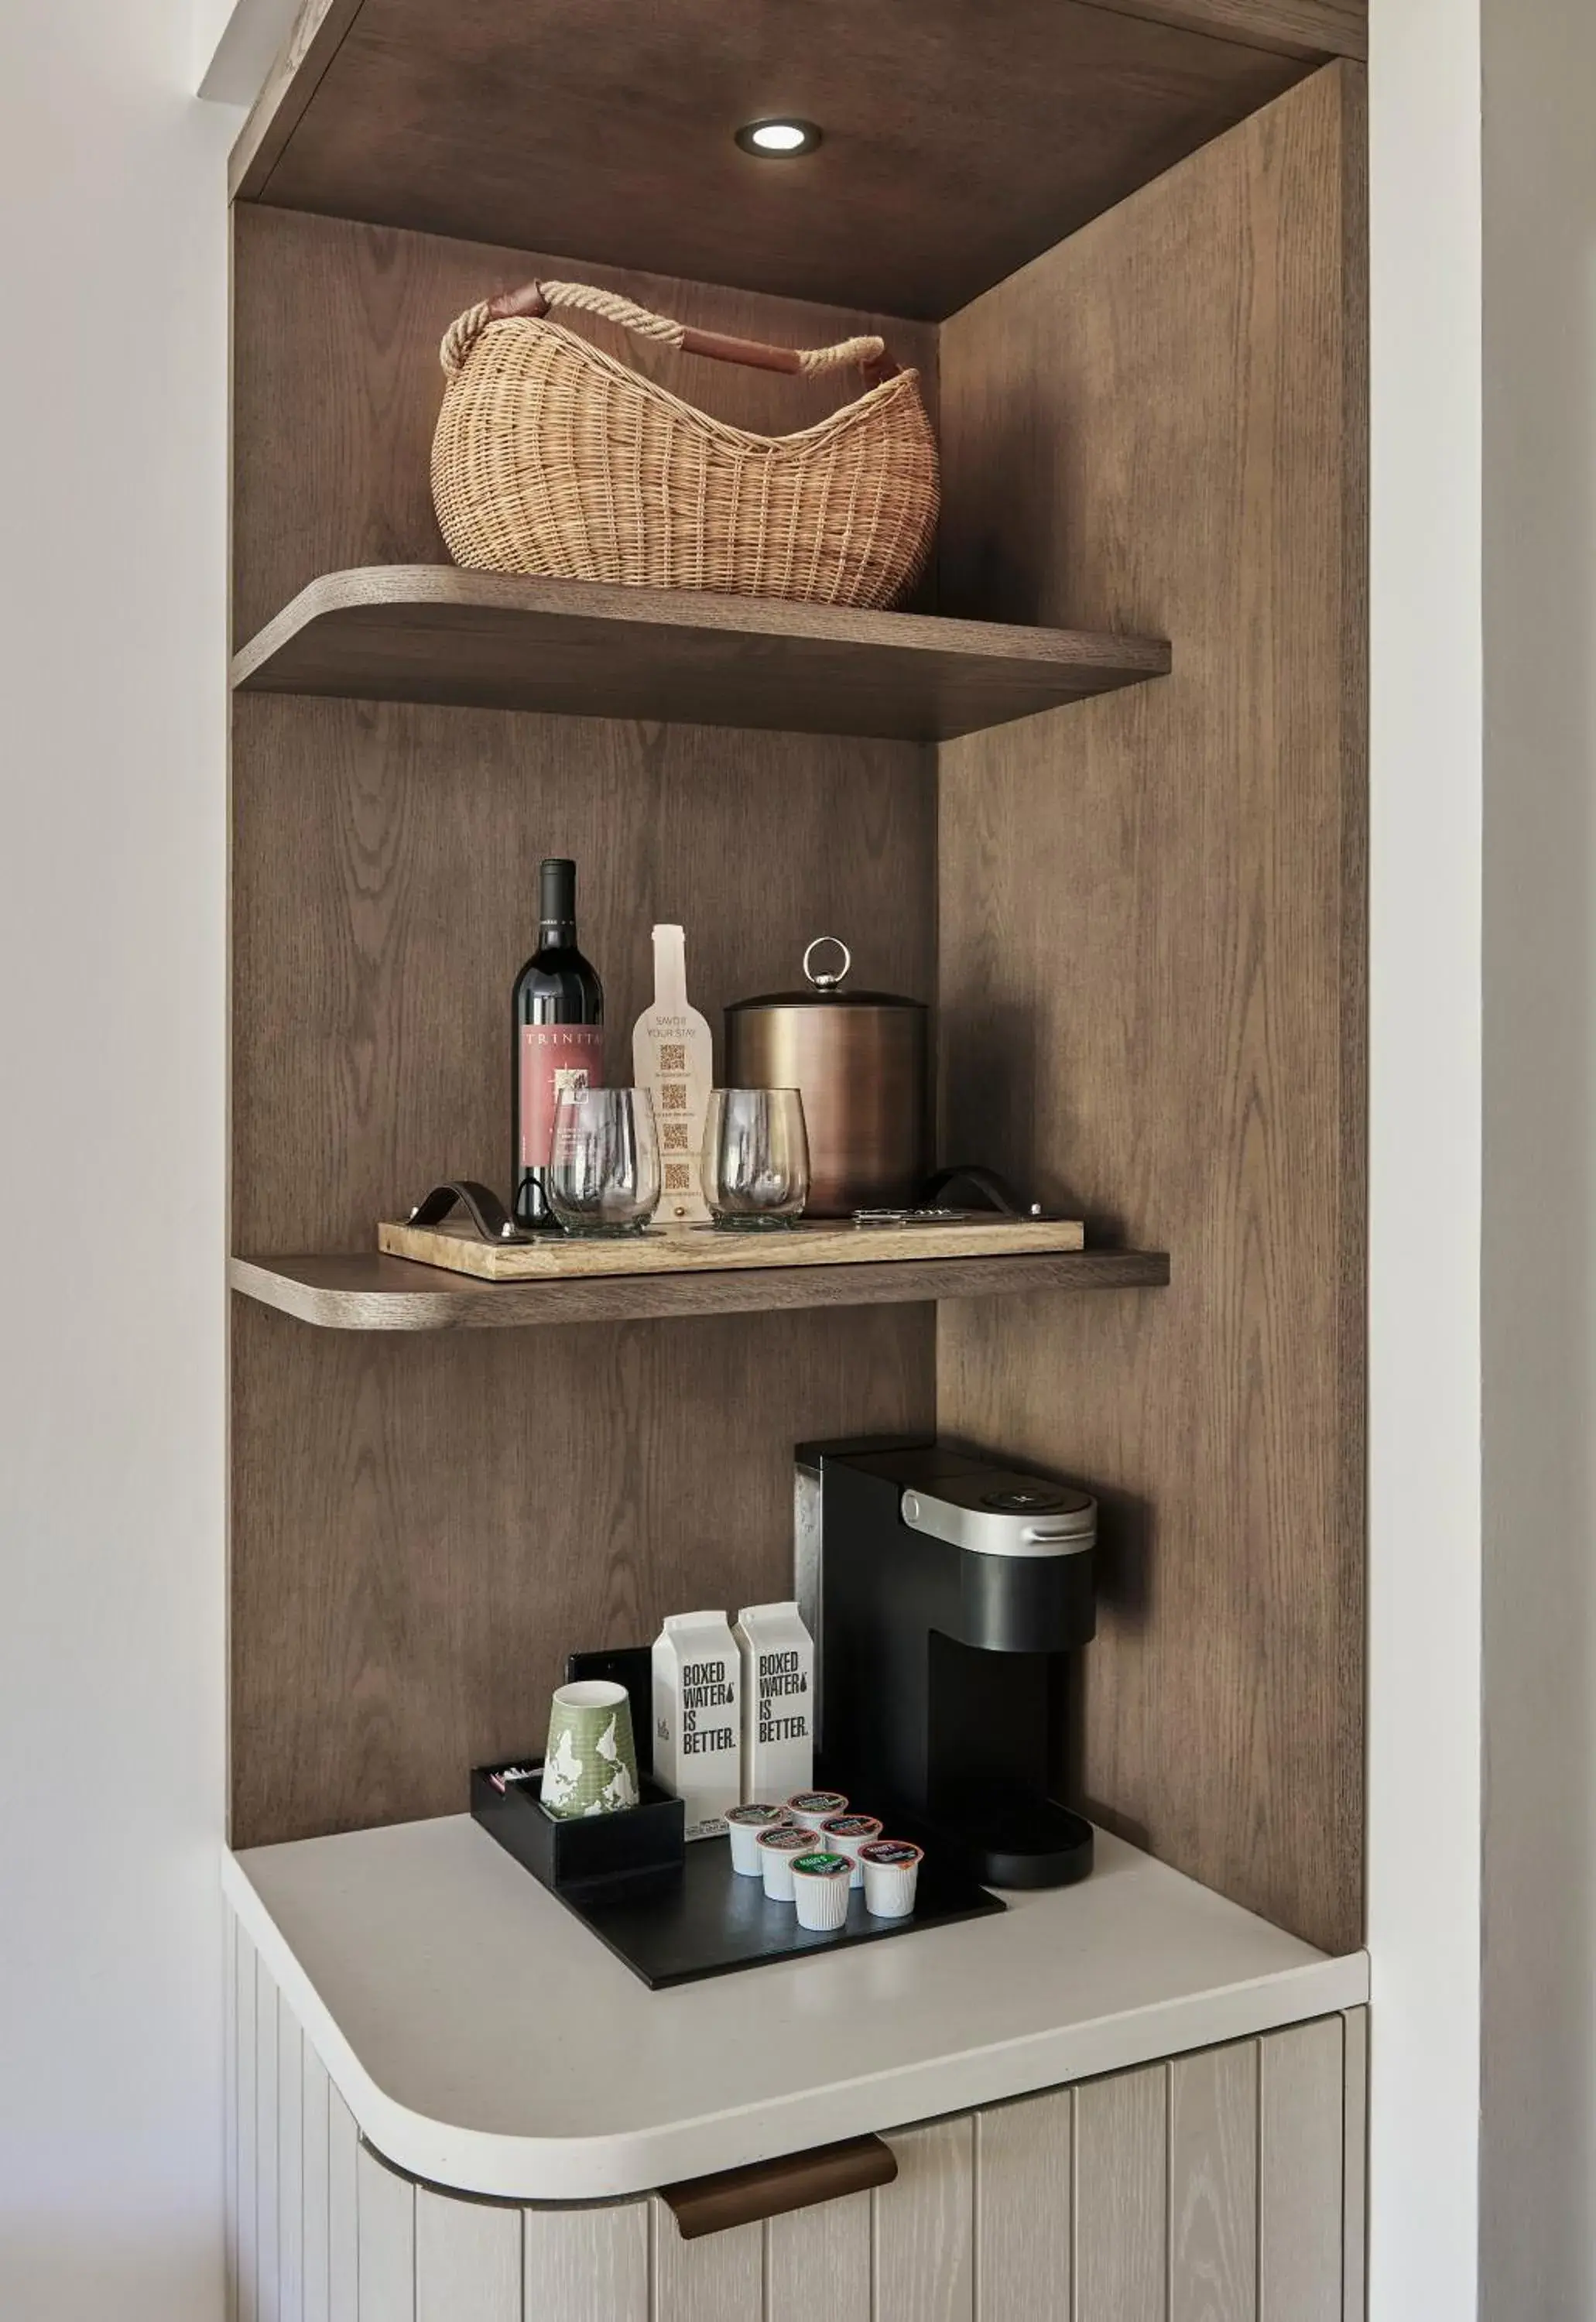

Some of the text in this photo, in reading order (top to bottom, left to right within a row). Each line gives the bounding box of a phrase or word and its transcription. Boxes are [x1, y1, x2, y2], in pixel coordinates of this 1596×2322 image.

[683, 1661, 725, 1687] BOXED
[759, 1651, 798, 1677] BOXED
[683, 1685, 725, 1709] WATER
[759, 1673, 800, 1699] WATER
[683, 1711, 697, 1732] IS
[759, 1700, 772, 1721] IS
[683, 1728, 736, 1755] BETTER.
